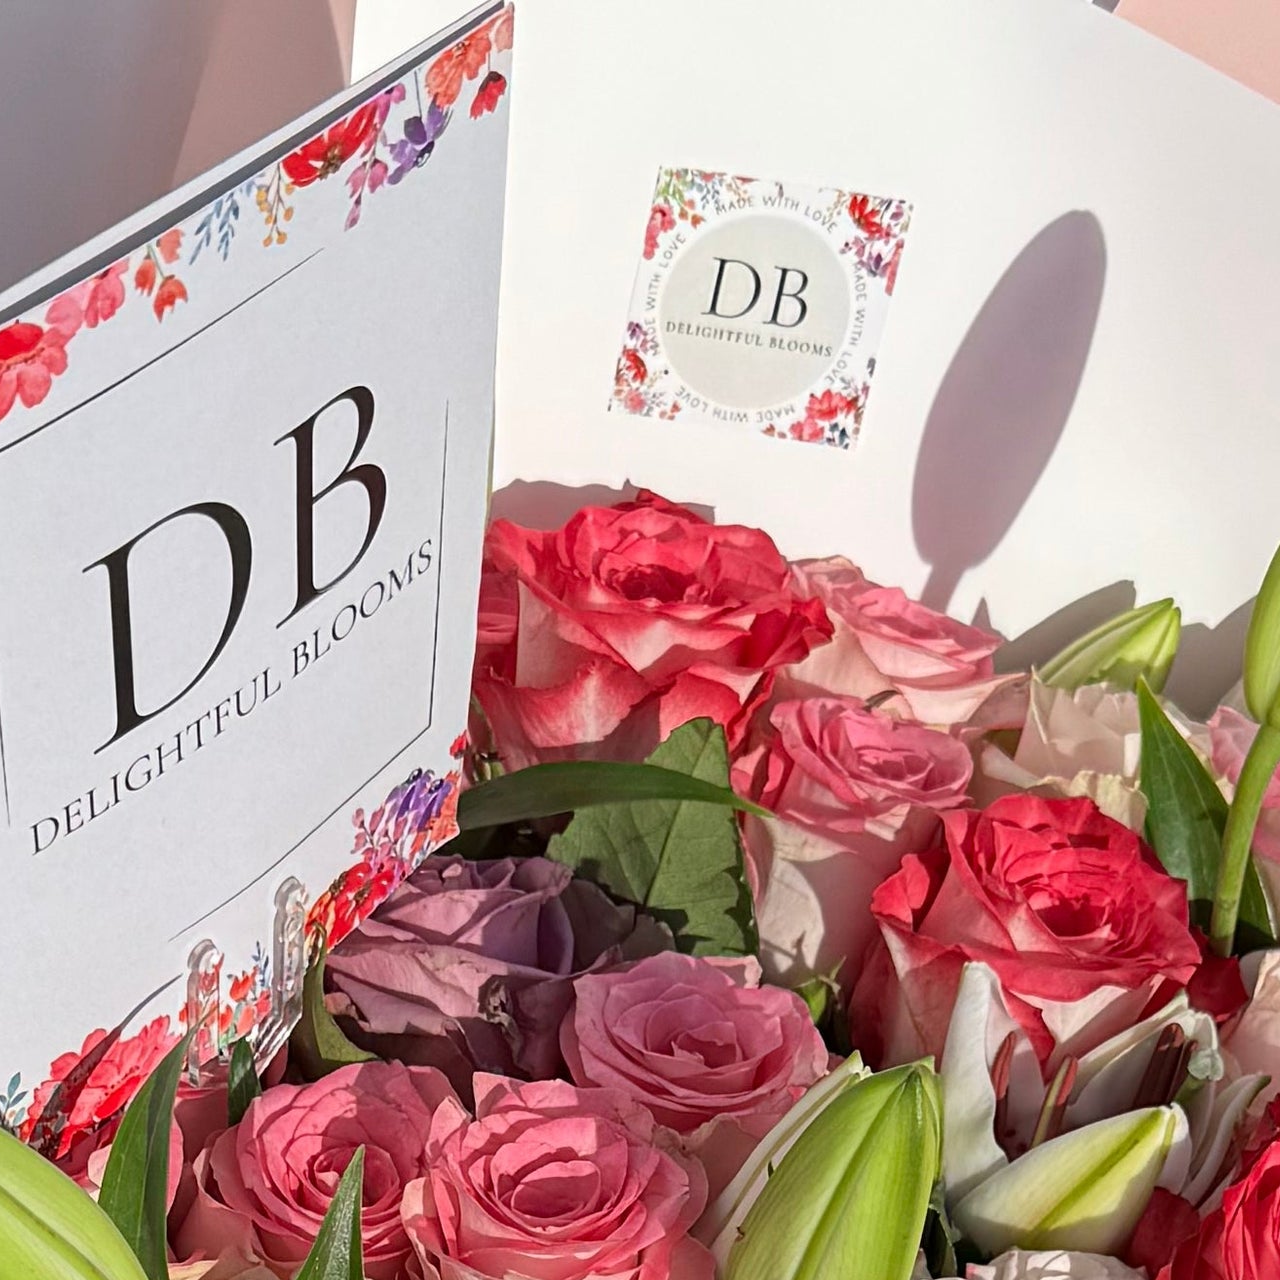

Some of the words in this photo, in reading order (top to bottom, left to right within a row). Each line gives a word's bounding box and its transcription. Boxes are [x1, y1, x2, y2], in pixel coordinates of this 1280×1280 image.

[715, 196, 755, 215] MADE
[763, 195, 800, 211] WITH
[804, 206, 839, 234] LOVE
[645, 274, 661, 311] WITH
[659, 234, 686, 268] LOVE
[701, 257, 809, 328] DB
[666, 321, 763, 347] DELIGHTFUL
[769, 337, 834, 357] BLOOMS
[850, 309, 866, 347] WITH
[825, 351, 853, 384] LOVE
[674, 386, 708, 412] LOVE
[712, 406, 749, 424] WITH
[82, 385, 387, 755] DB
[29, 666, 282, 857] DELIGHTFUL
[290, 538, 435, 682] BLOOMS
